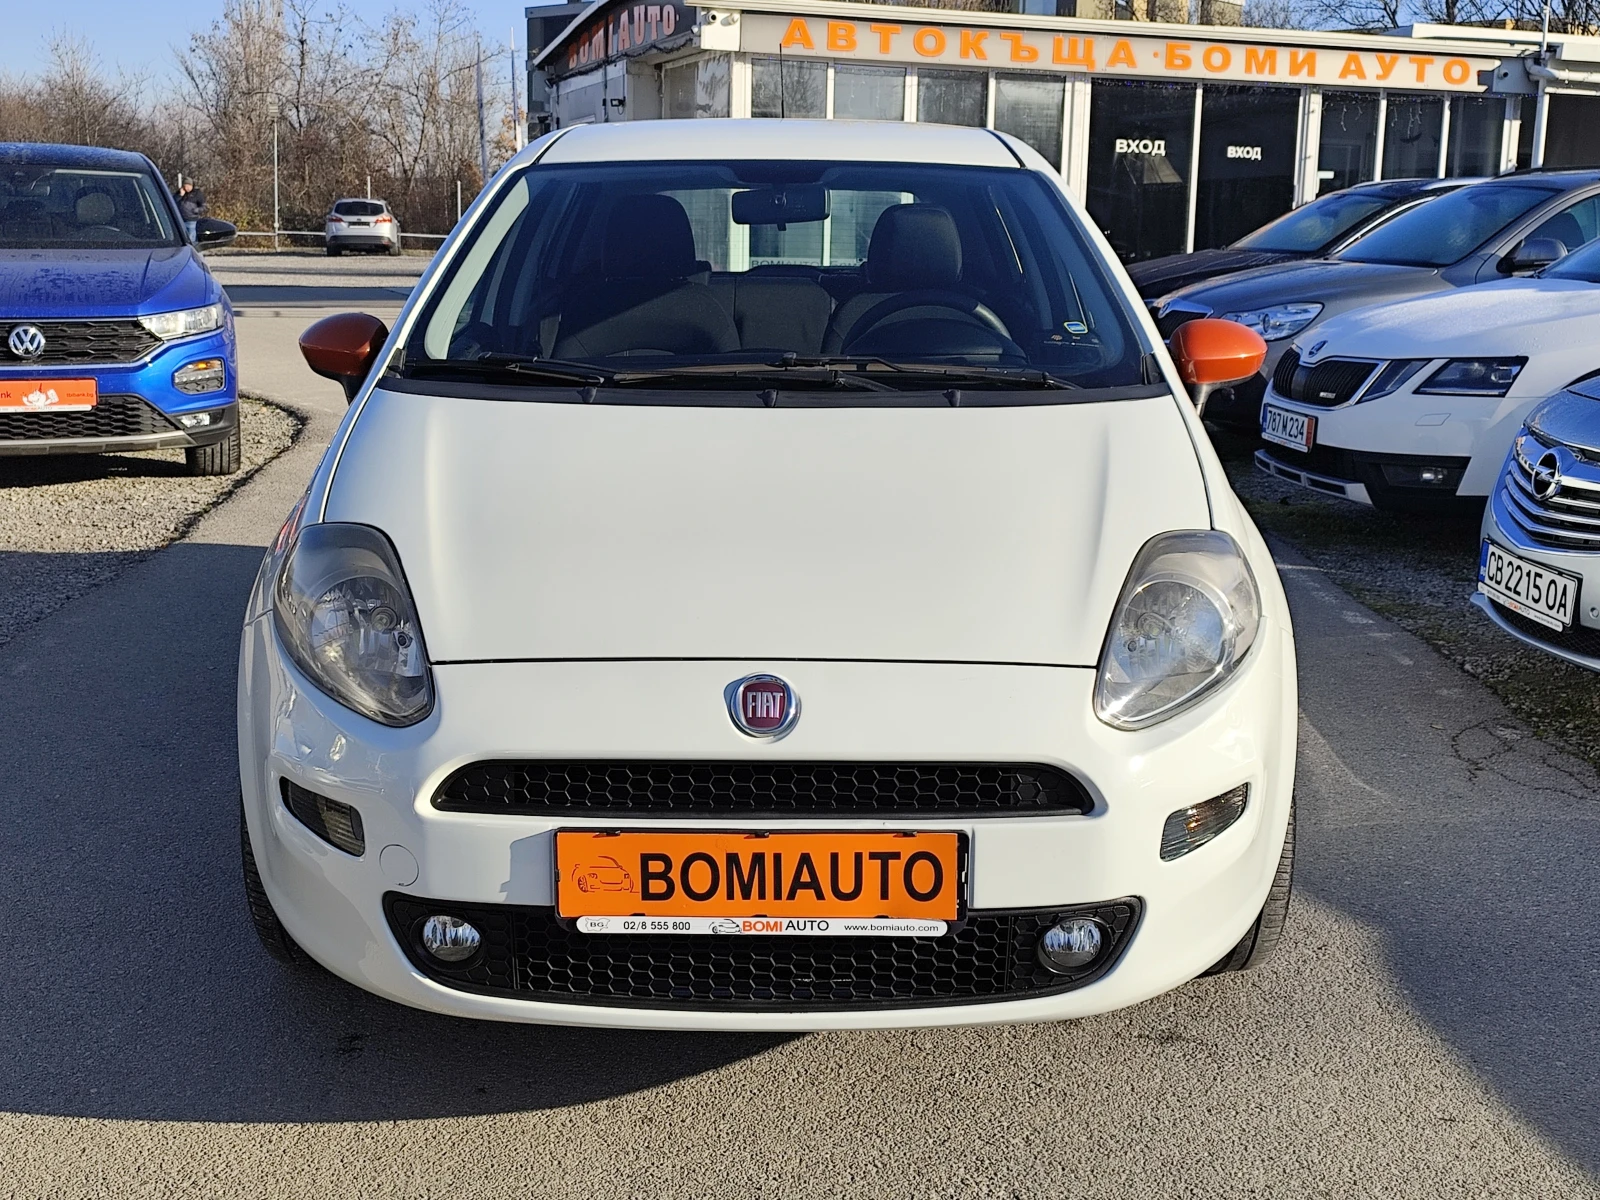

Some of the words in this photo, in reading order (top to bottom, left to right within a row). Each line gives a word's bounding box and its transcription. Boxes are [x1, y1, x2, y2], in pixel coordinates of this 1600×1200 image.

[781, 18, 1138, 71] АВТОКЪЩА
[1164, 41, 1318, 78] БОМИ
[1338, 53, 1471, 85] АУТО
[1115, 138, 1166, 156] ВХОД
[1227, 146, 1262, 161] ВХОД
[746, 691, 783, 718] FIAT
[639, 850, 944, 903] BOMIAUTO
[623, 920, 647, 931] 02/8
[650, 921, 669, 931] 555
[672, 921, 691, 931] 800
[742, 920, 783, 932] BOMI
[785, 920, 829, 931] AUTO
[843, 923, 939, 932] www.bomiauto.com
